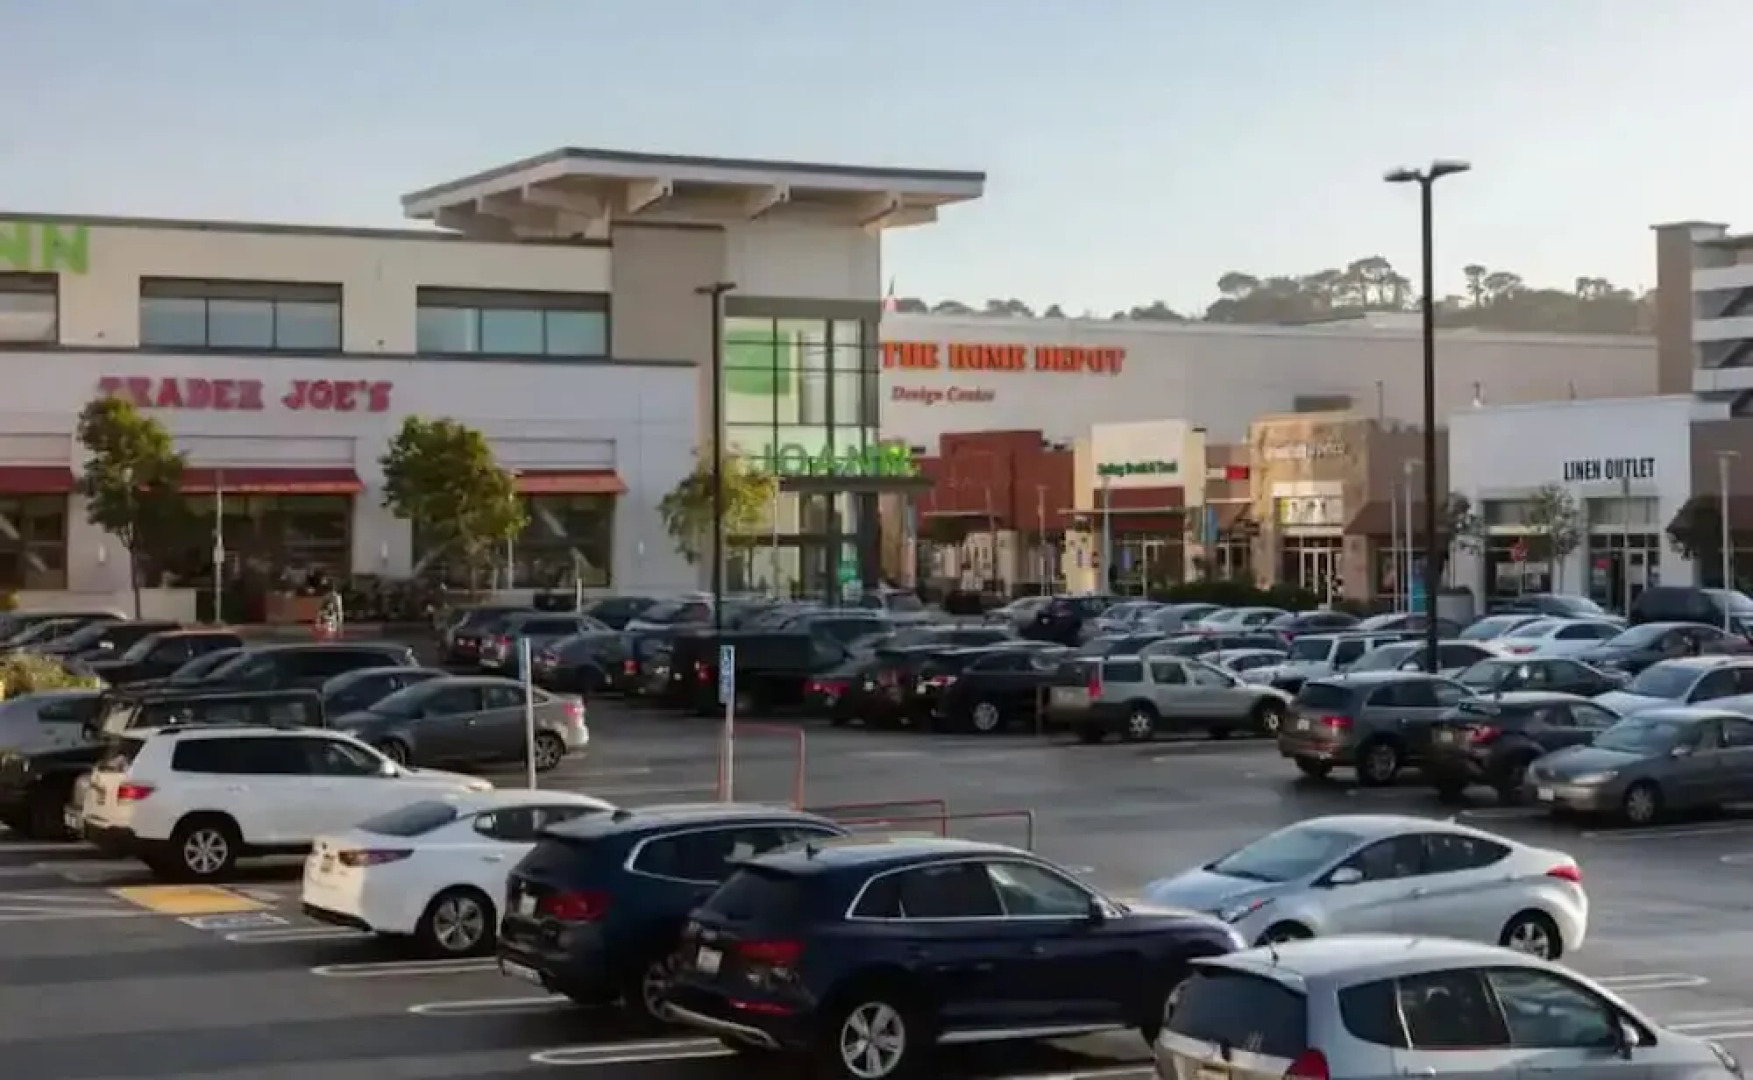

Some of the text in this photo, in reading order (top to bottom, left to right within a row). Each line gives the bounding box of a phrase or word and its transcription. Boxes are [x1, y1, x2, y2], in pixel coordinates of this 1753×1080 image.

[881, 343, 1126, 374] THE HOME DEPOT
[281, 379, 394, 412] JOE'S
[891, 386, 996, 404] Design Center
[1564, 457, 1655, 481] LINEN OUTLET
